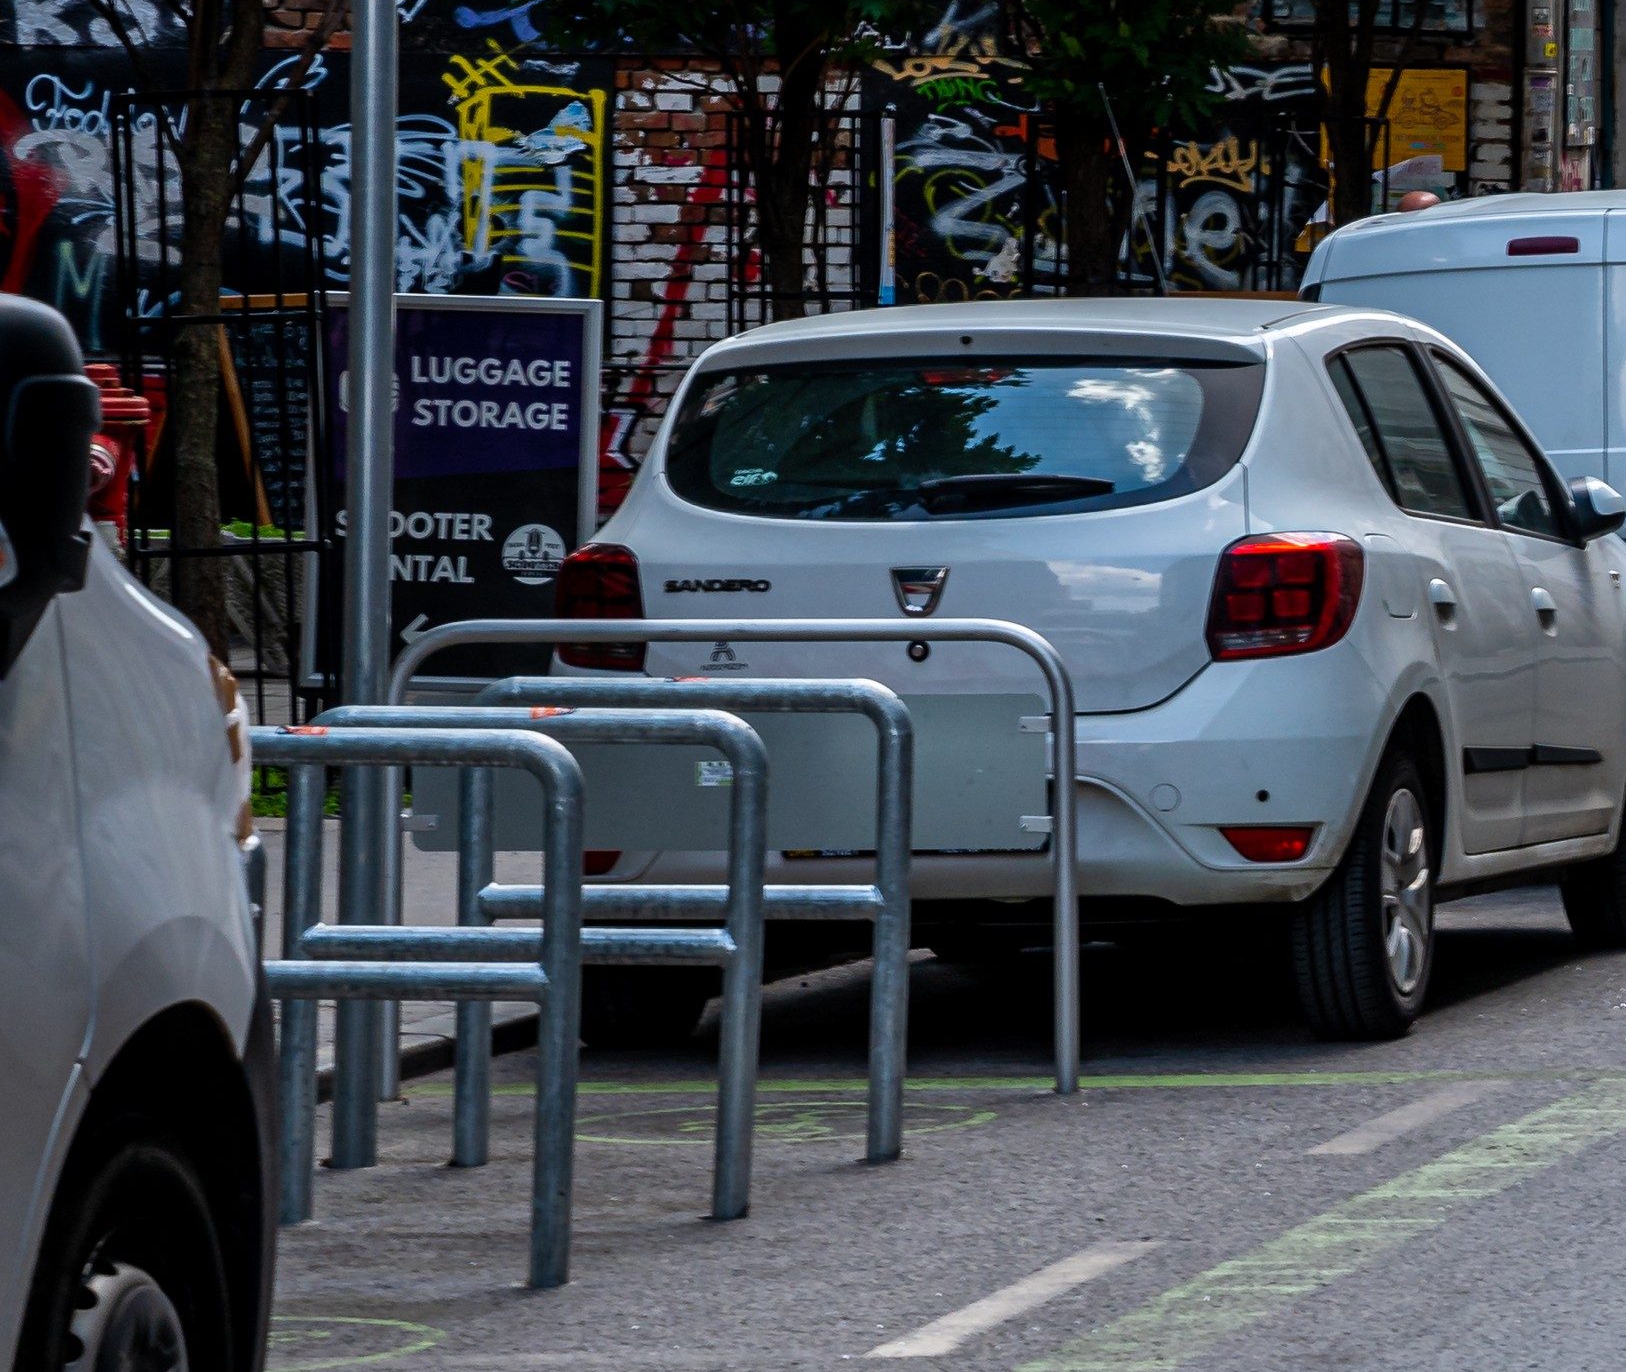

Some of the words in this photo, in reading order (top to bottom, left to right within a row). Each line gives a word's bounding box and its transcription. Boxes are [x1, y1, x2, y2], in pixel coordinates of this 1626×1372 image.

[410, 355, 571, 388] LUGGAGE
[411, 398, 570, 431] STORAGE
[335, 510, 494, 541] SOOTER
[388, 554, 476, 583] NTAL
[663, 579, 771, 593] SANDERO
